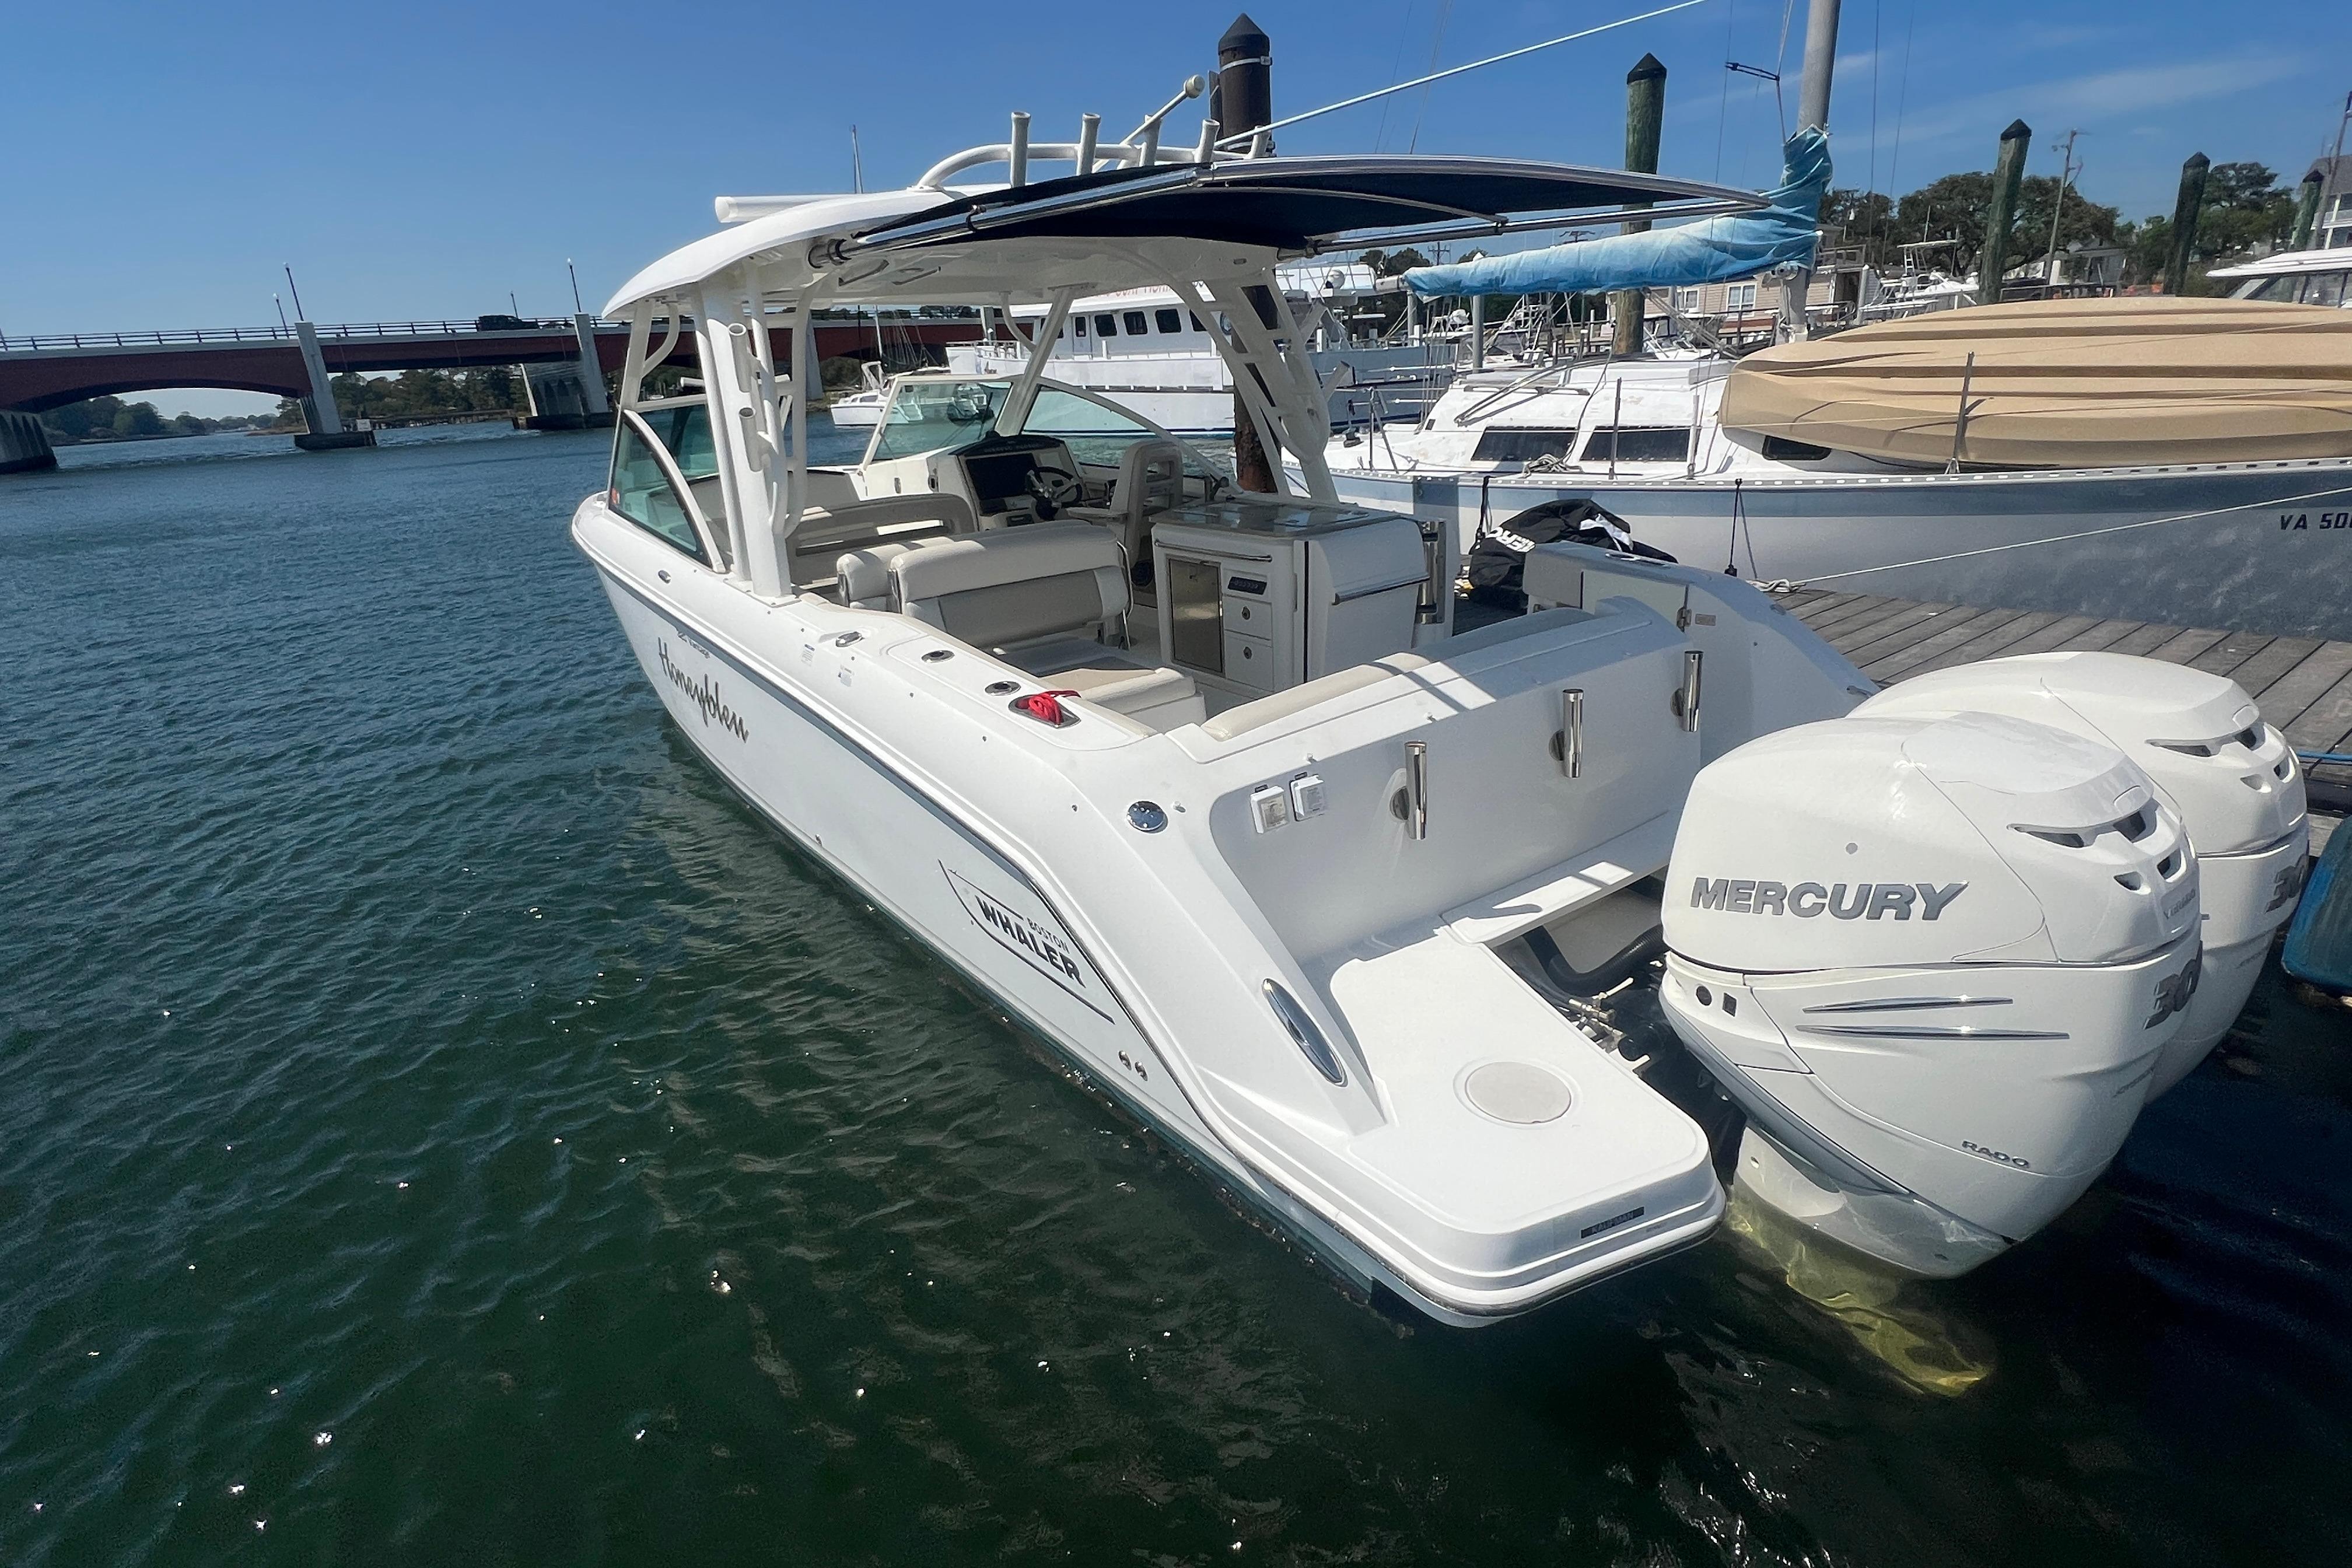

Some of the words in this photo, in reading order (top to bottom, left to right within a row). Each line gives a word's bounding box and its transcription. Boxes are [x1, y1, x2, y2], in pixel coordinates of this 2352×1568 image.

[2280, 513, 2308, 530] VA
[2319, 512, 2352, 530] 50
[1690, 877, 1969, 921] MERCURY
[975, 894, 1086, 988] WHALER
[1026, 917, 1070, 954] BOSTON
